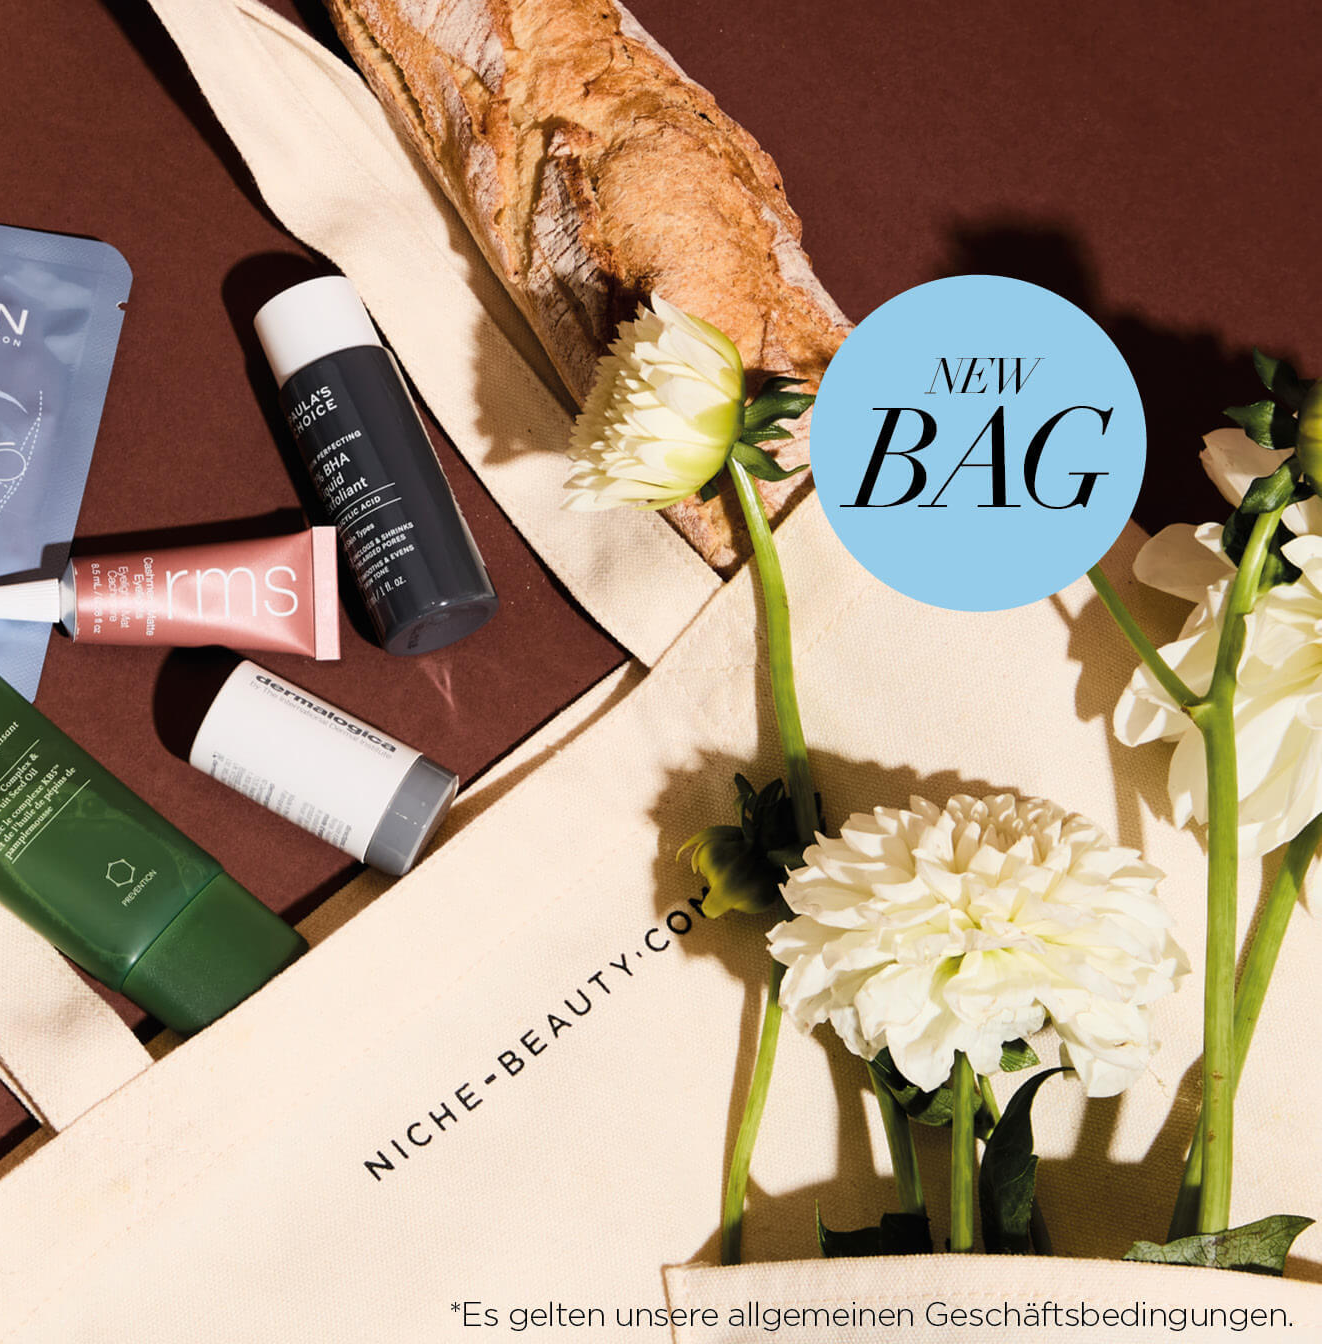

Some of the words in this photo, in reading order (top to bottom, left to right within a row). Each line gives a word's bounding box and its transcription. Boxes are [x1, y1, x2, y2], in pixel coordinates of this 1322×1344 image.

[289, 386, 332, 422] AULA'S
[294, 399, 337, 437] HOICE
[316, 430, 362, 460] PERFECTING
[323, 452, 351, 477] BHA
[326, 477, 369, 514] xfoliant
[360, 495, 381, 511] ACID
[380, 521, 414, 541] SHRINKS
[381, 533, 407, 550] PORES
[389, 544, 415, 561] EVENS
[165, 565, 299, 621] rms
[255, 674, 397, 753] dermalogica
[29, 752, 40, 762] &
[8, 779, 28, 799] Seed
[25, 767, 39, 784] Oil
[3, 829, 15, 843] de
[34, 798, 46, 811] de
[43, 776, 69, 803] pépins
[64, 766, 77, 779] de
[4, 816, 13, 828] le
[11, 784, 44, 819] complexe
[4, 804, 55, 861] pamplemousse
[121, 869, 157, 907] PREVENTION
